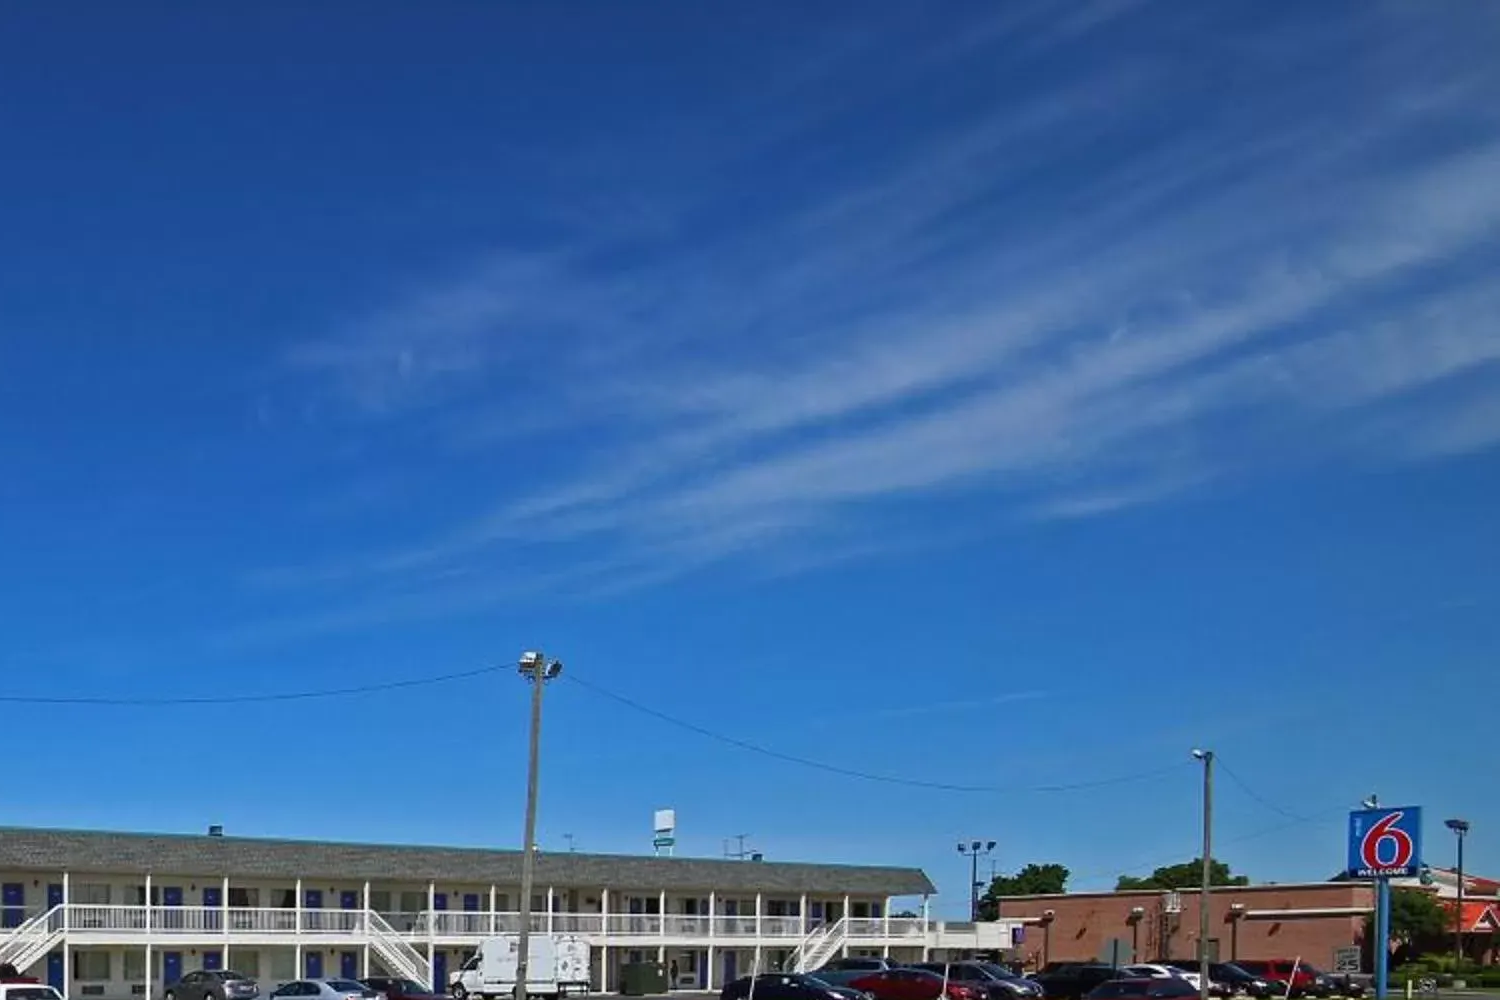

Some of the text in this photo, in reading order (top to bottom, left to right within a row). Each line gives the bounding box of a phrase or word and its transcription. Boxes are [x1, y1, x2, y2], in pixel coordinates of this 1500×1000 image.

[1360, 811, 1413, 869] 6
[1357, 867, 1409, 877] WELCOME
[1336, 959, 1359, 971] 25
